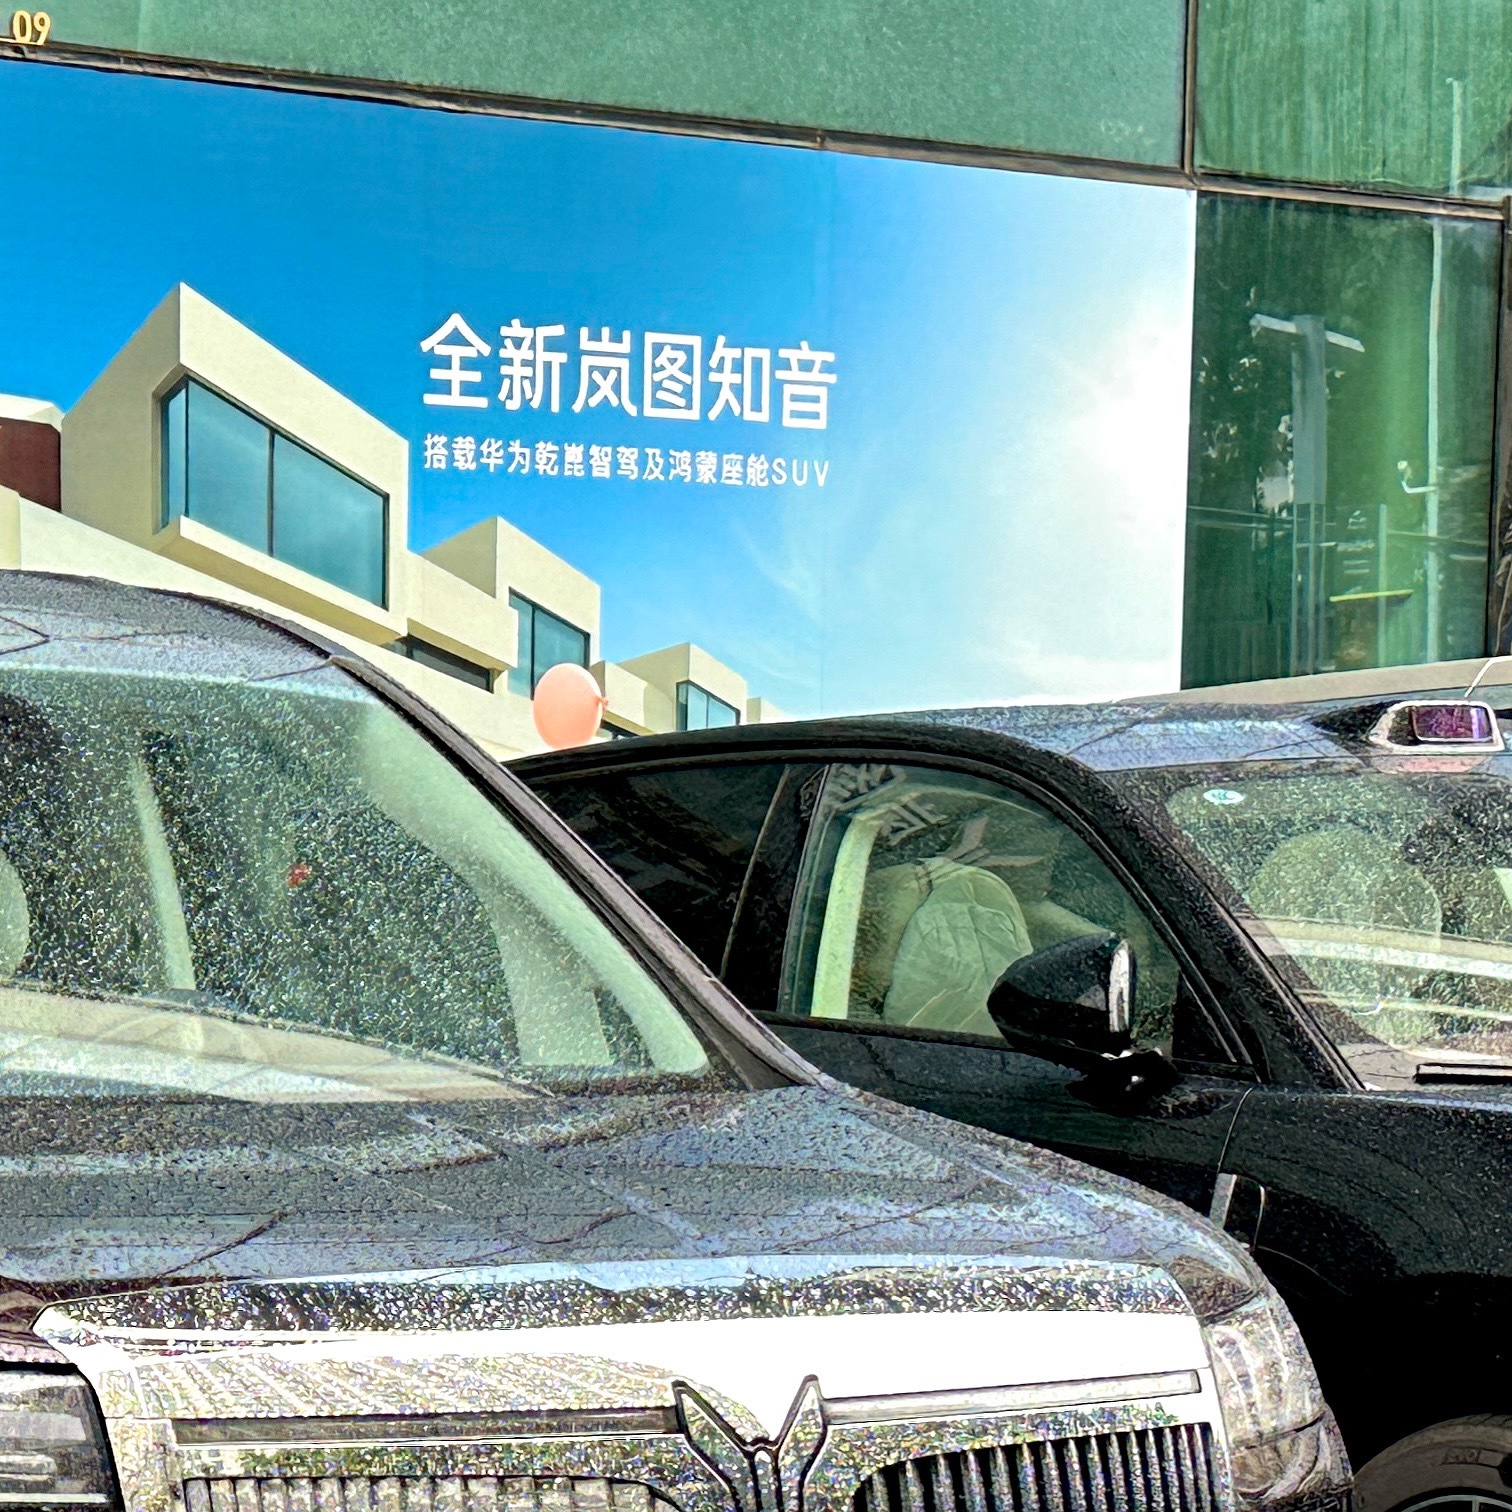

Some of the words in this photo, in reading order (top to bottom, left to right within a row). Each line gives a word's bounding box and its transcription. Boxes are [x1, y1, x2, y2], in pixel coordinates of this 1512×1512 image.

[420, 312, 838, 430] 全新岚图知音
